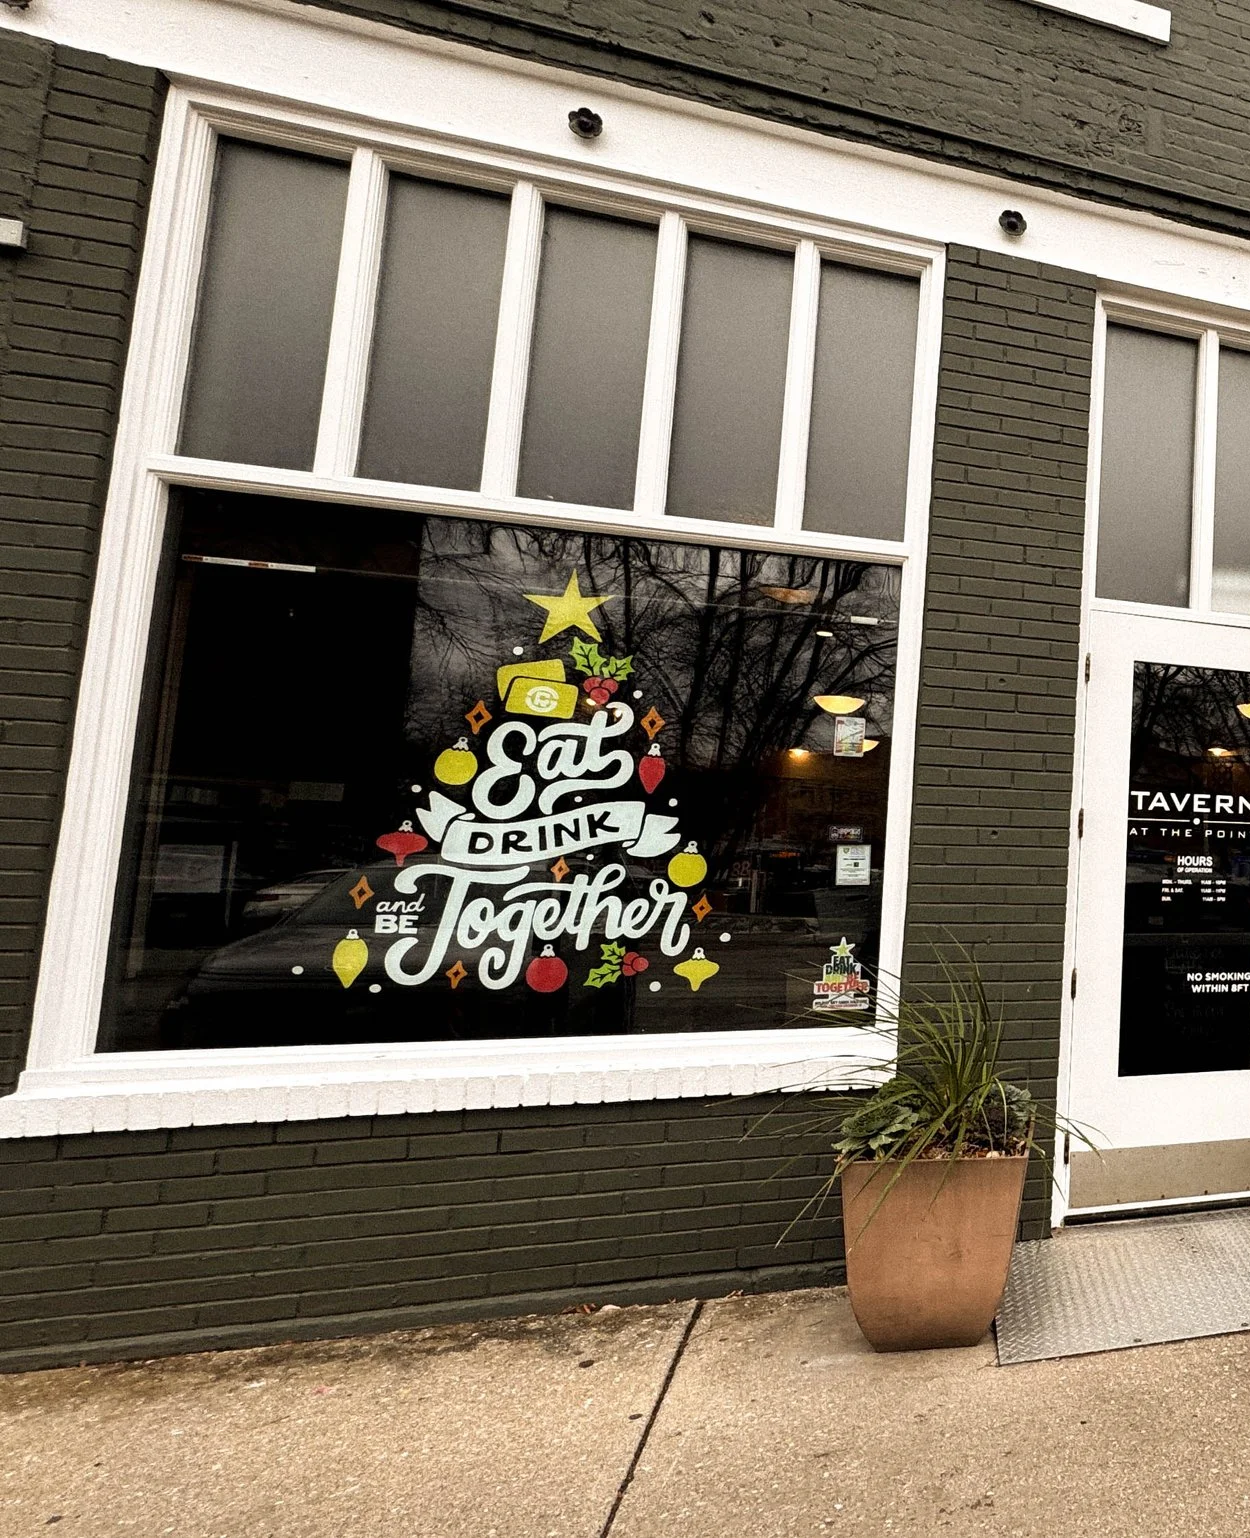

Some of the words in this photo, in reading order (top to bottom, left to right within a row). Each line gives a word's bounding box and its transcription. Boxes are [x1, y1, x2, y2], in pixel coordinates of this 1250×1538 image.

[472, 702, 634, 819] Eat
[467, 811, 620, 854] DRINK
[1129, 827, 1149, 836] AT
[1160, 828, 1192, 838] THE
[1177, 855, 1213, 867] HOURS
[375, 893, 425, 914] and
[374, 914, 419, 934] BE
[384, 863, 690, 990] Together
[1186, 972, 1203, 981] NO
[1205, 971, 1250, 981] SMOKING
[1191, 984, 1229, 993] WITHIN
[1231, 983, 1250, 993] 8FT
